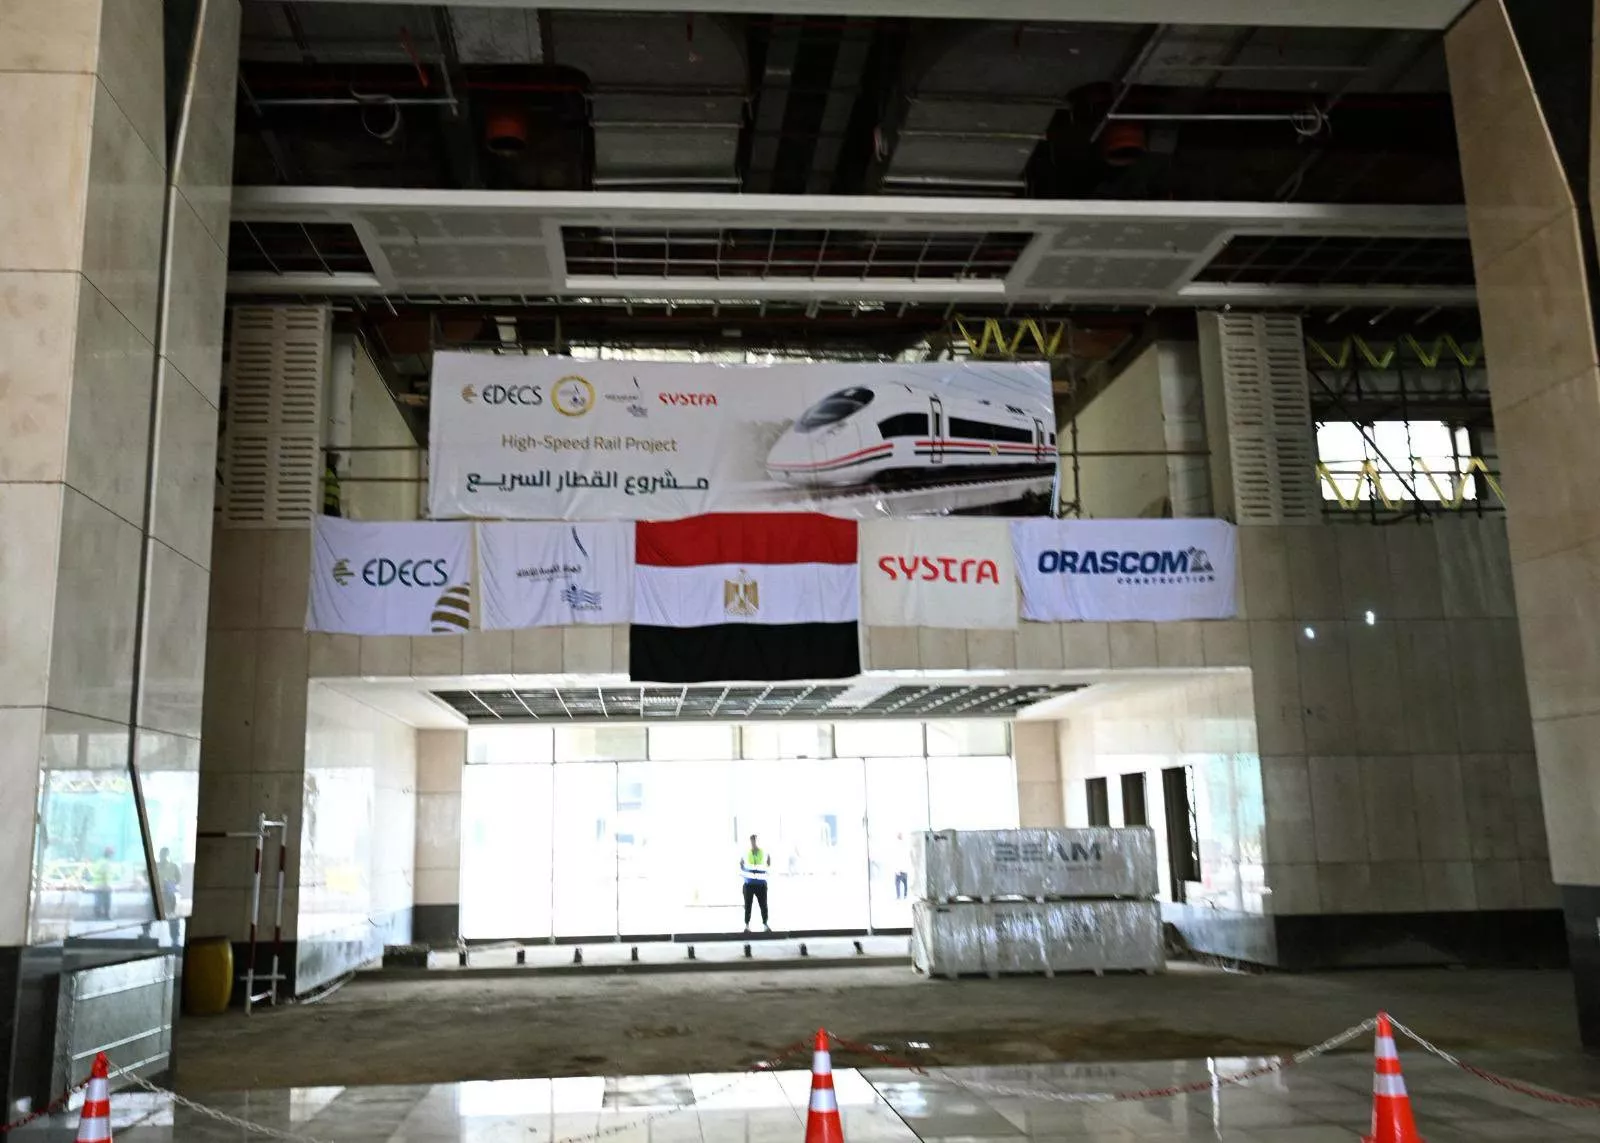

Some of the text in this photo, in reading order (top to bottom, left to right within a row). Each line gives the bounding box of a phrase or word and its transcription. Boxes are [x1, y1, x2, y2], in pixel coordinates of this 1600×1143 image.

[482, 385, 543, 406] EDECS
[501, 433, 678, 454] High-Speed Rail Project
[466, 469, 709, 496] مشروع القطار السريع
[362, 558, 448, 588] EDECS
[878, 556, 1000, 586] SYSTRA
[1038, 550, 1189, 575] ORASCOM
